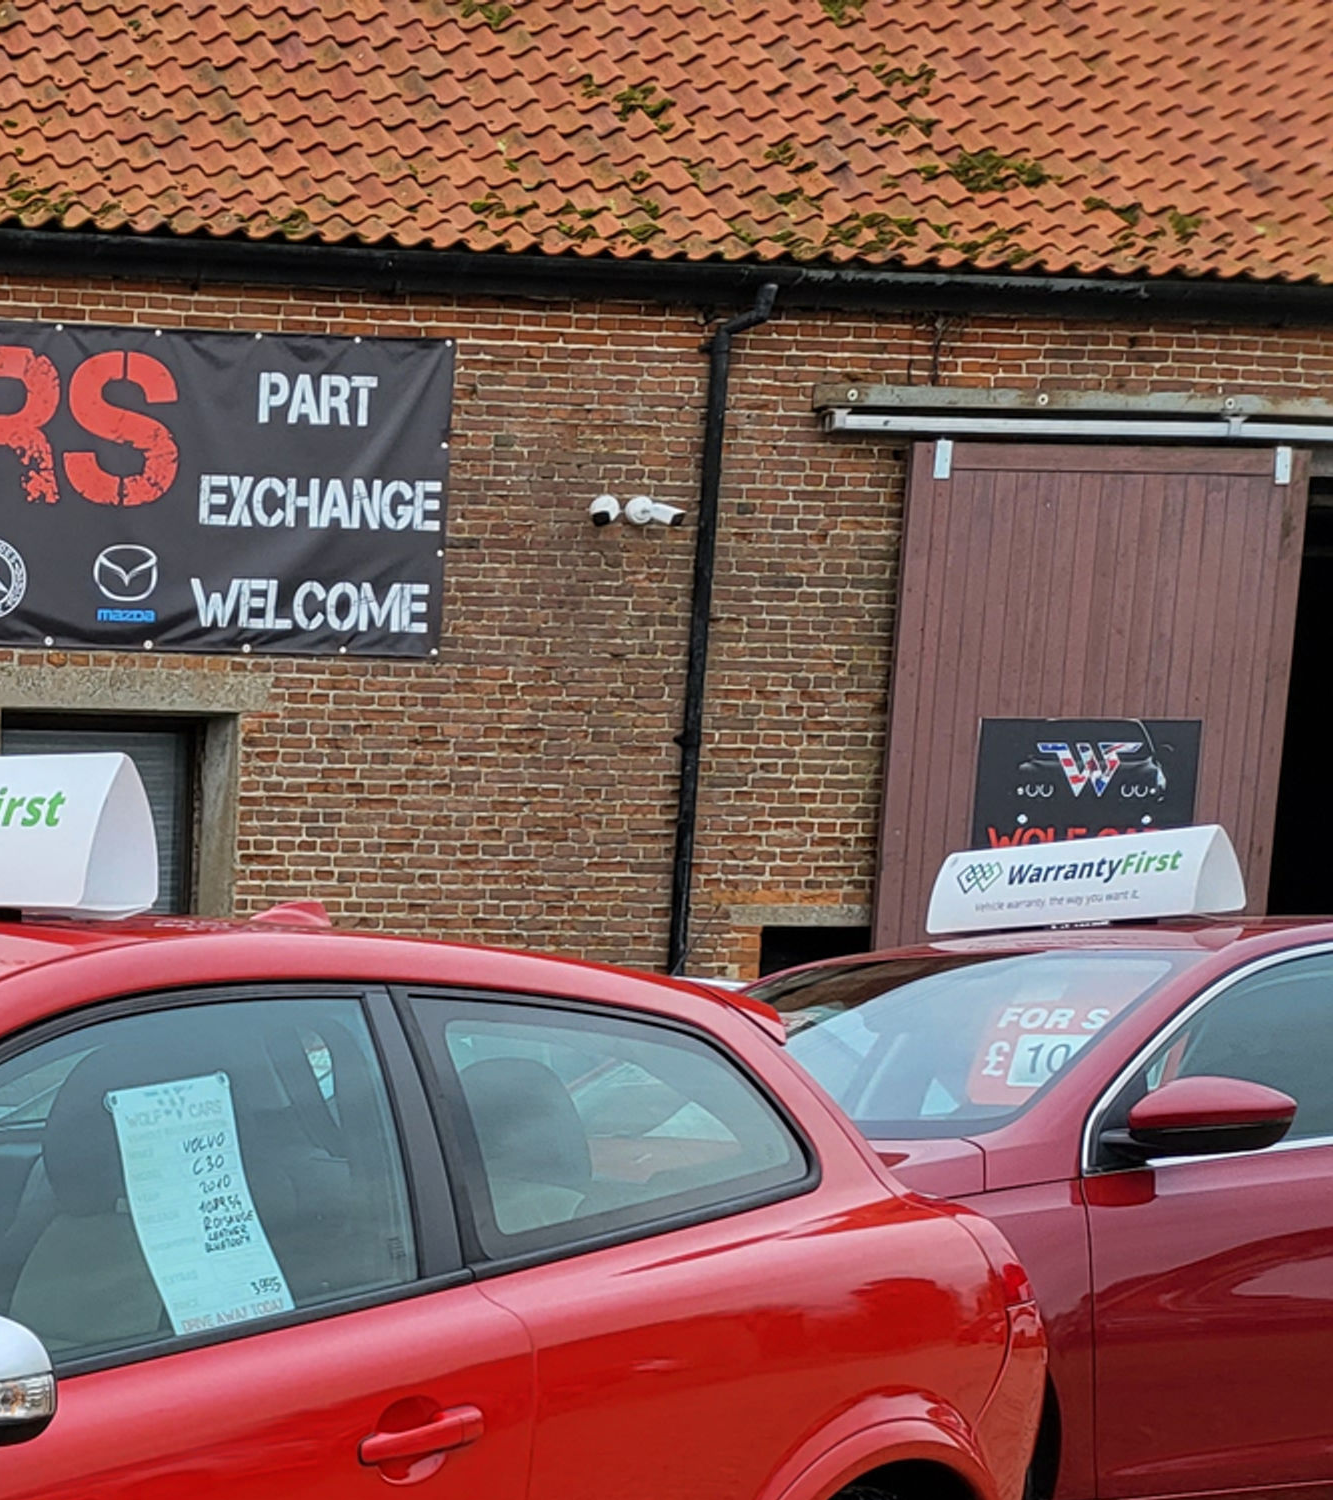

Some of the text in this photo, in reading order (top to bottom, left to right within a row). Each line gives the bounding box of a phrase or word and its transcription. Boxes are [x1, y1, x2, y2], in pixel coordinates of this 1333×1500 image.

[258, 372, 378, 427] PART
[198, 474, 442, 533] EXCHANGE
[96, 606, 156, 624] mazda
[190, 577, 429, 634] WELCOME
[1007, 850, 1183, 886] WarrantyFirst
[997, 1007, 1075, 1030] FOR
[183, 1132, 226, 1154] VOLVO
[192, 1154, 225, 1176] C30
[199, 1174, 231, 1195] 2010
